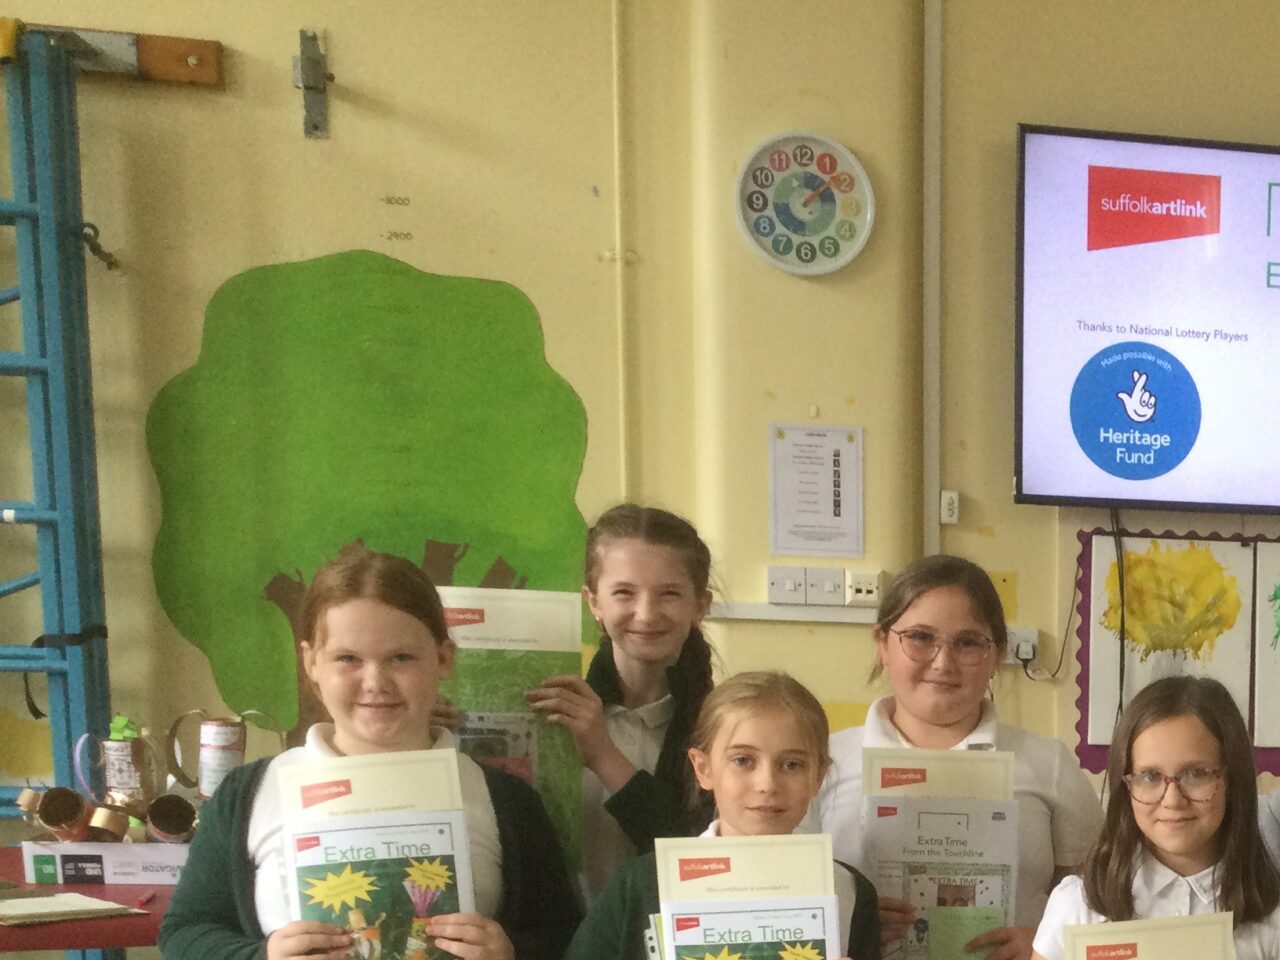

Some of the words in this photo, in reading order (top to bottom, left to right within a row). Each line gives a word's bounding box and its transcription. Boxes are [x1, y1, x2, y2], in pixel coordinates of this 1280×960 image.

[773, 153, 787, 168] 11
[795, 147, 812, 166] 12
[756, 170, 772, 185] 10
[1101, 194, 1207, 218] suffolkartlink
[1076, 320, 1113, 333] Thanks
[1115, 325, 1126, 334] to
[1129, 324, 1173, 337] National
[1175, 327, 1211, 342] Lottery
[1213, 330, 1249, 343] Players
[1099, 427, 1172, 449] Heritage
[1116, 447, 1155, 465] Fund
[917, 836, 944, 847] Extra
[945, 836, 968, 847] Time
[324, 845, 376, 863] Extra
[381, 841, 431, 858] Time
[927, 848, 942, 857] the
[943, 848, 984, 858] Touchline
[703, 927, 753, 944] Extra
[758, 925, 804, 942] Time
